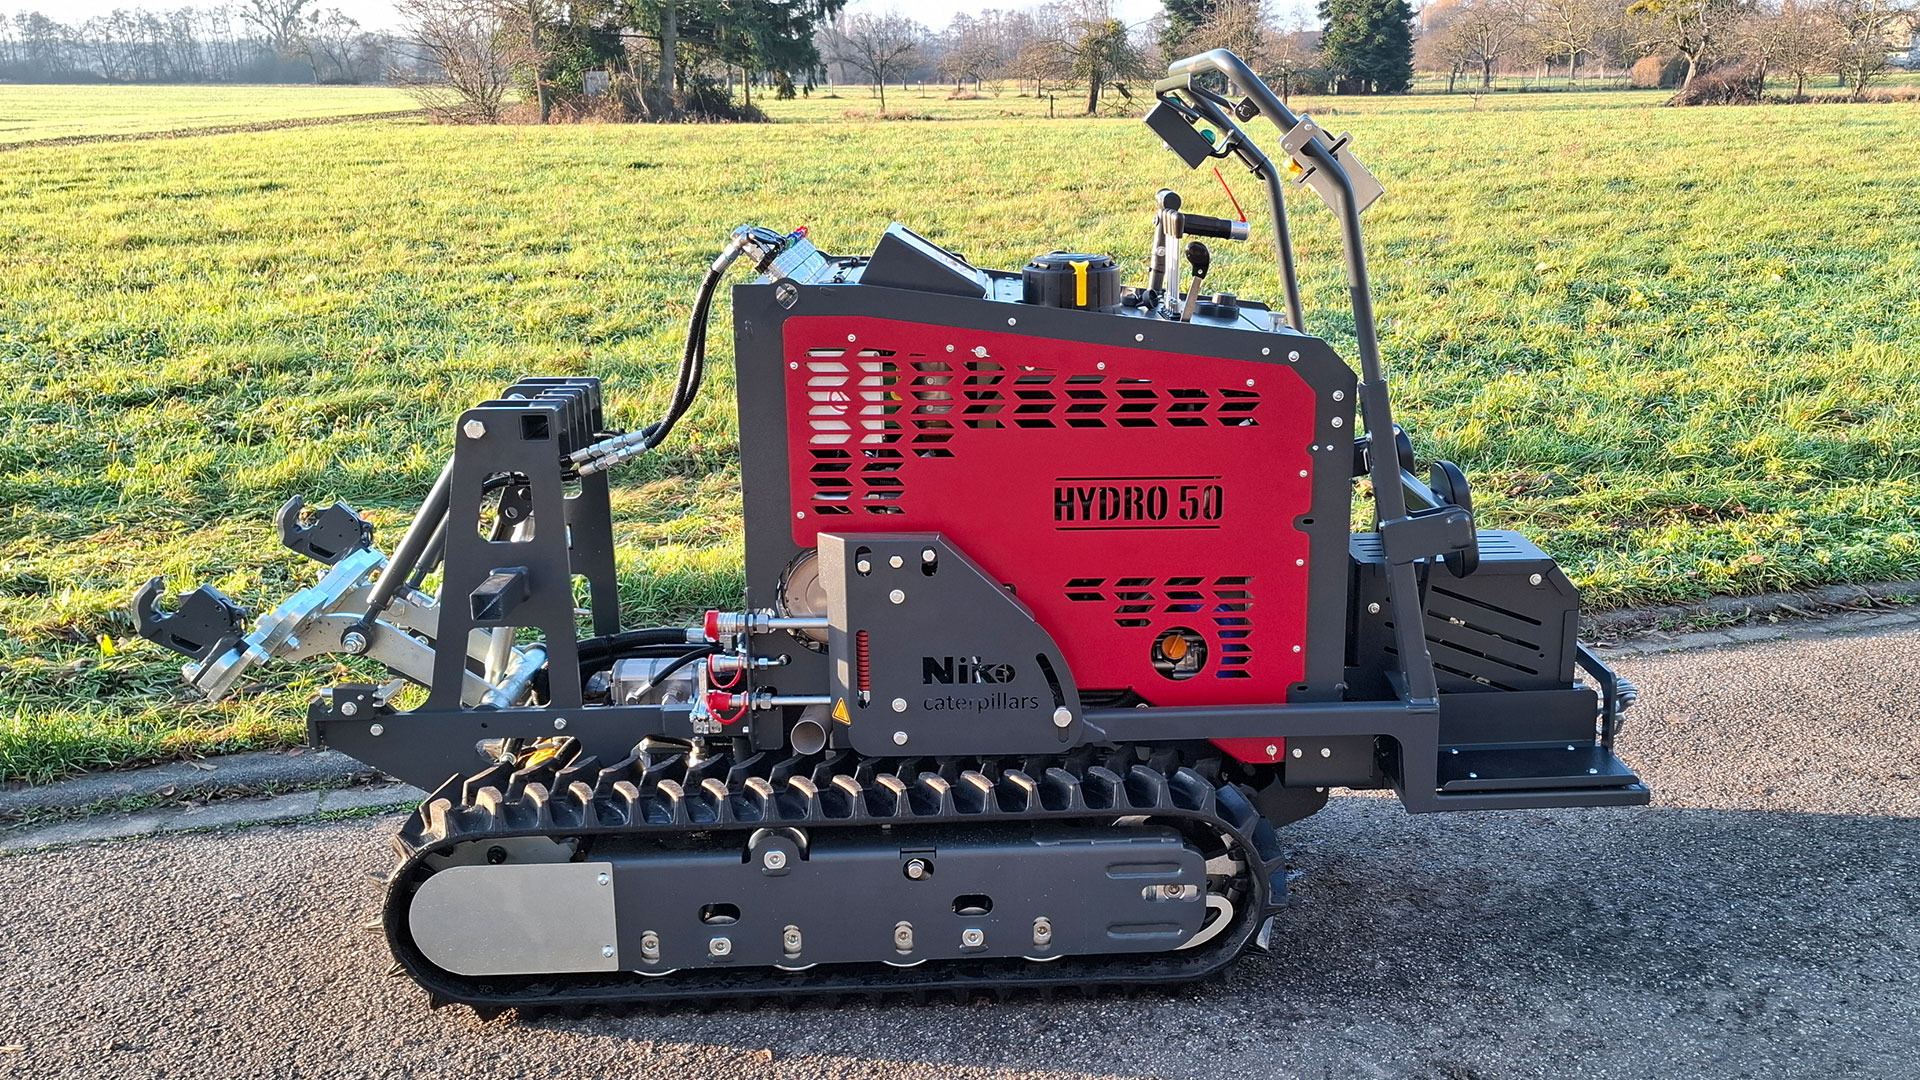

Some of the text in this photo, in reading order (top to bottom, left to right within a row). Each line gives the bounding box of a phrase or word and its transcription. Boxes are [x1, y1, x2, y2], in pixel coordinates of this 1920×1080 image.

[1054, 485, 1223, 520] HYDRO 50
[922, 656, 1016, 684] Niko
[923, 692, 1039, 713] caterpillars
